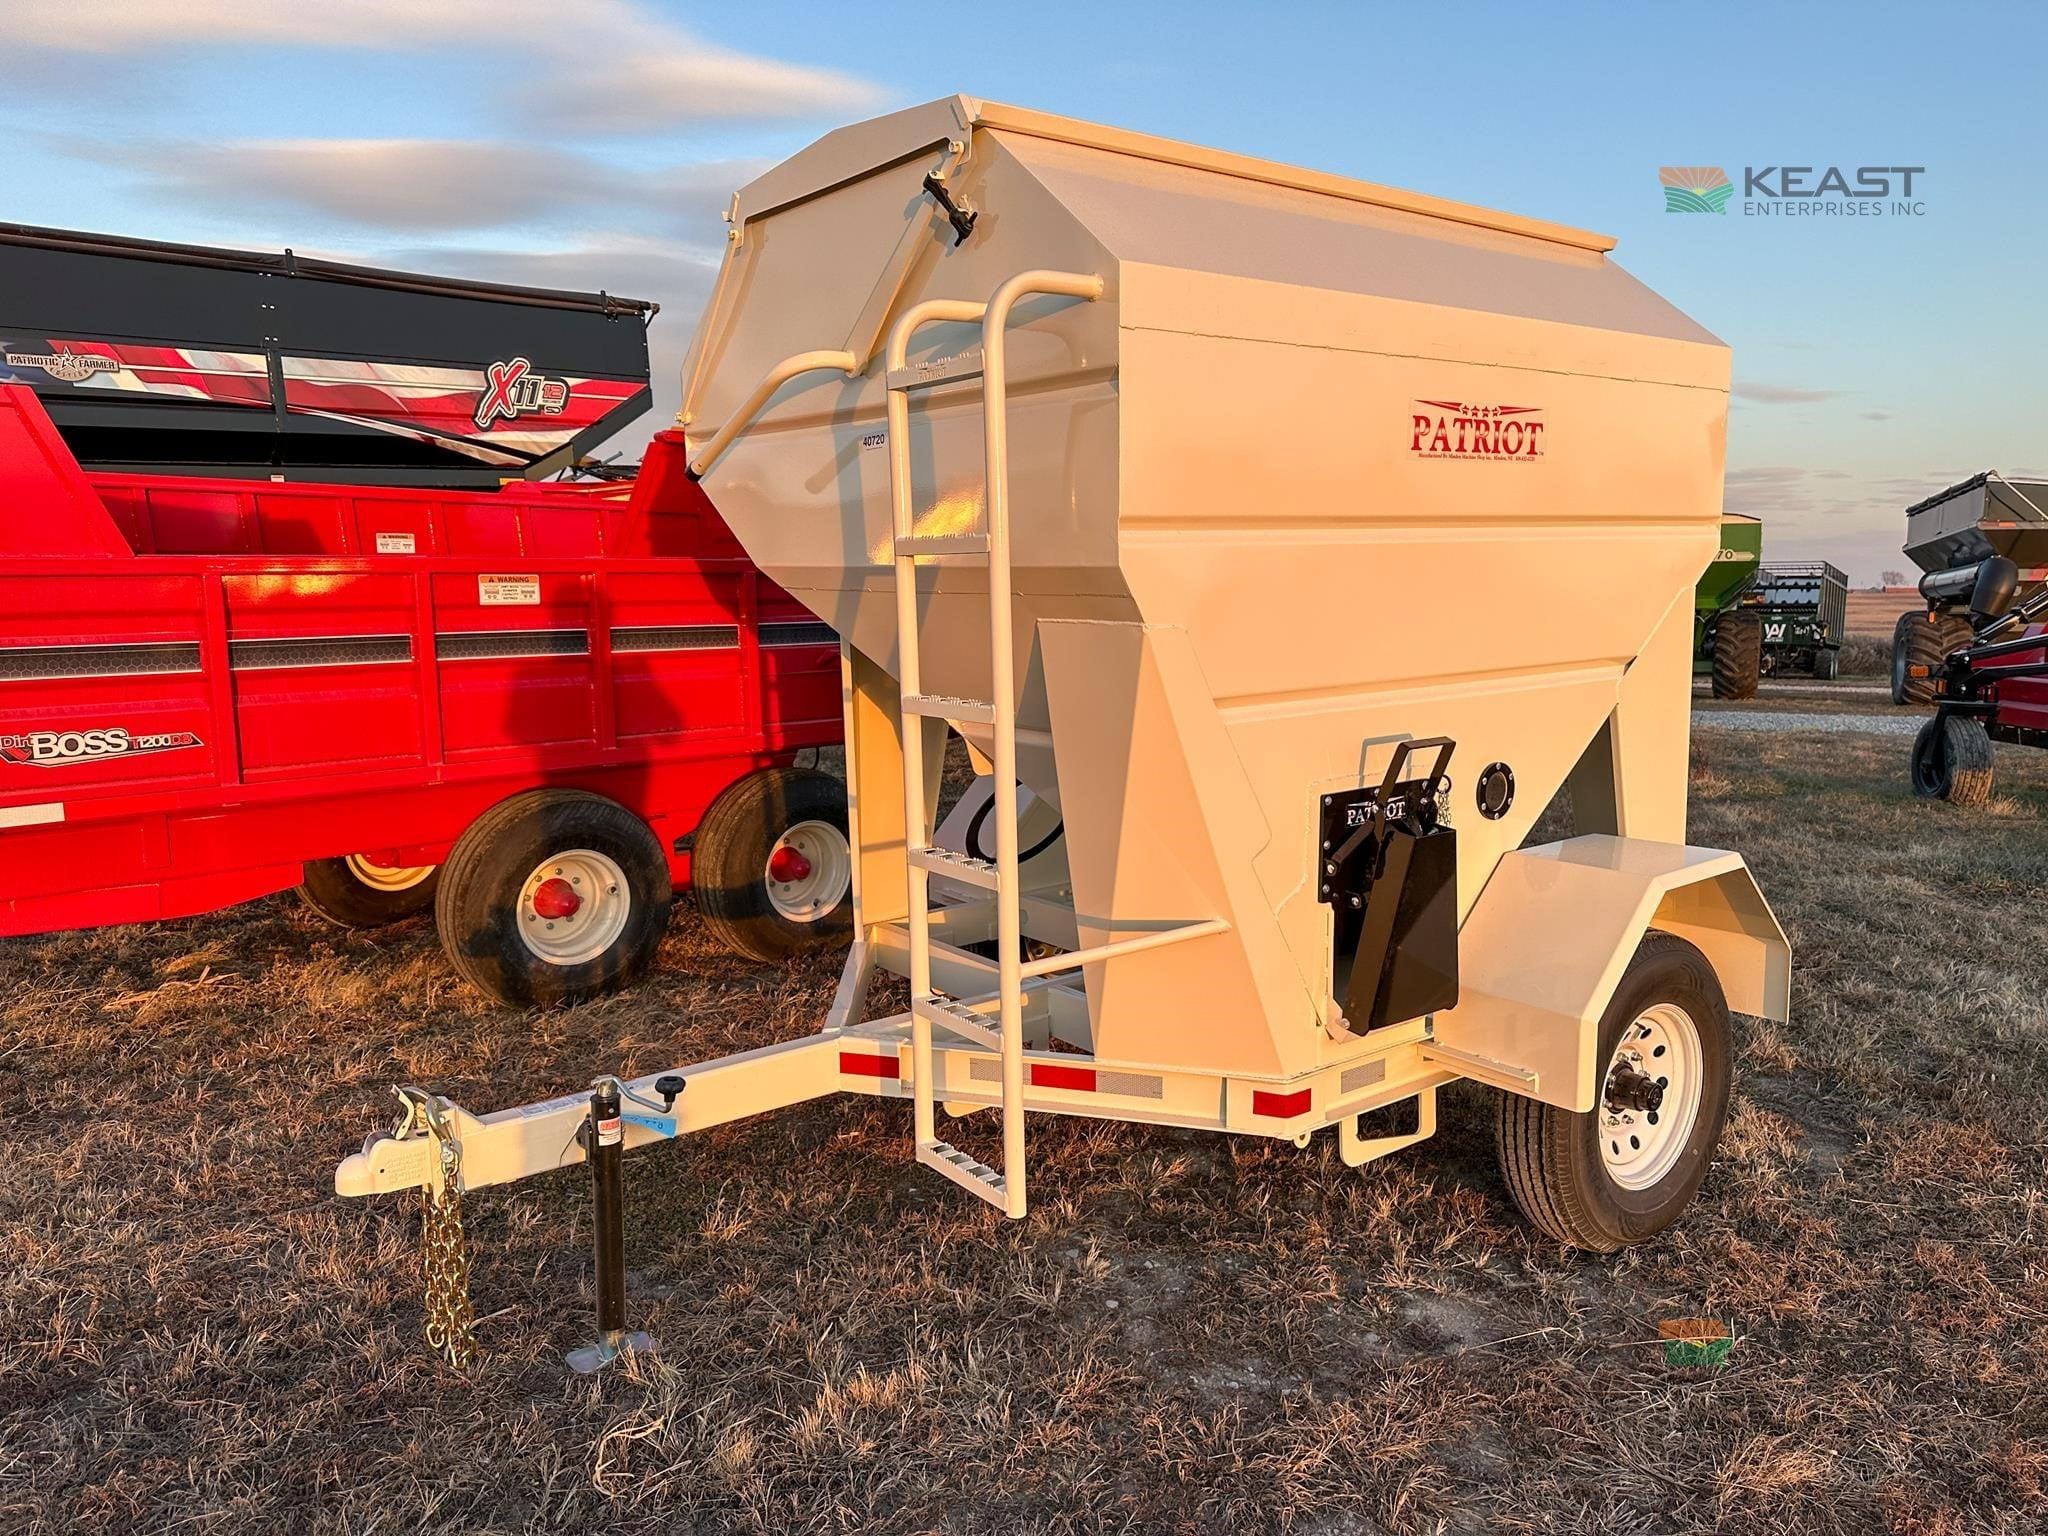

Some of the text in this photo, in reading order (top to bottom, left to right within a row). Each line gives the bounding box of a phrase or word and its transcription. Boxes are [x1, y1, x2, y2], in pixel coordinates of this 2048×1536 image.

[10, 355, 115, 369] PATRIOTIC FARMER
[863, 433, 885, 447] 40720
[1411, 415, 1544, 456] PATRIOT
[1713, 550, 1733, 560] 70
[1, 736, 32, 749] Dirt
[30, 729, 129, 759] BOSS
[1347, 801, 1405, 825] PATOT
